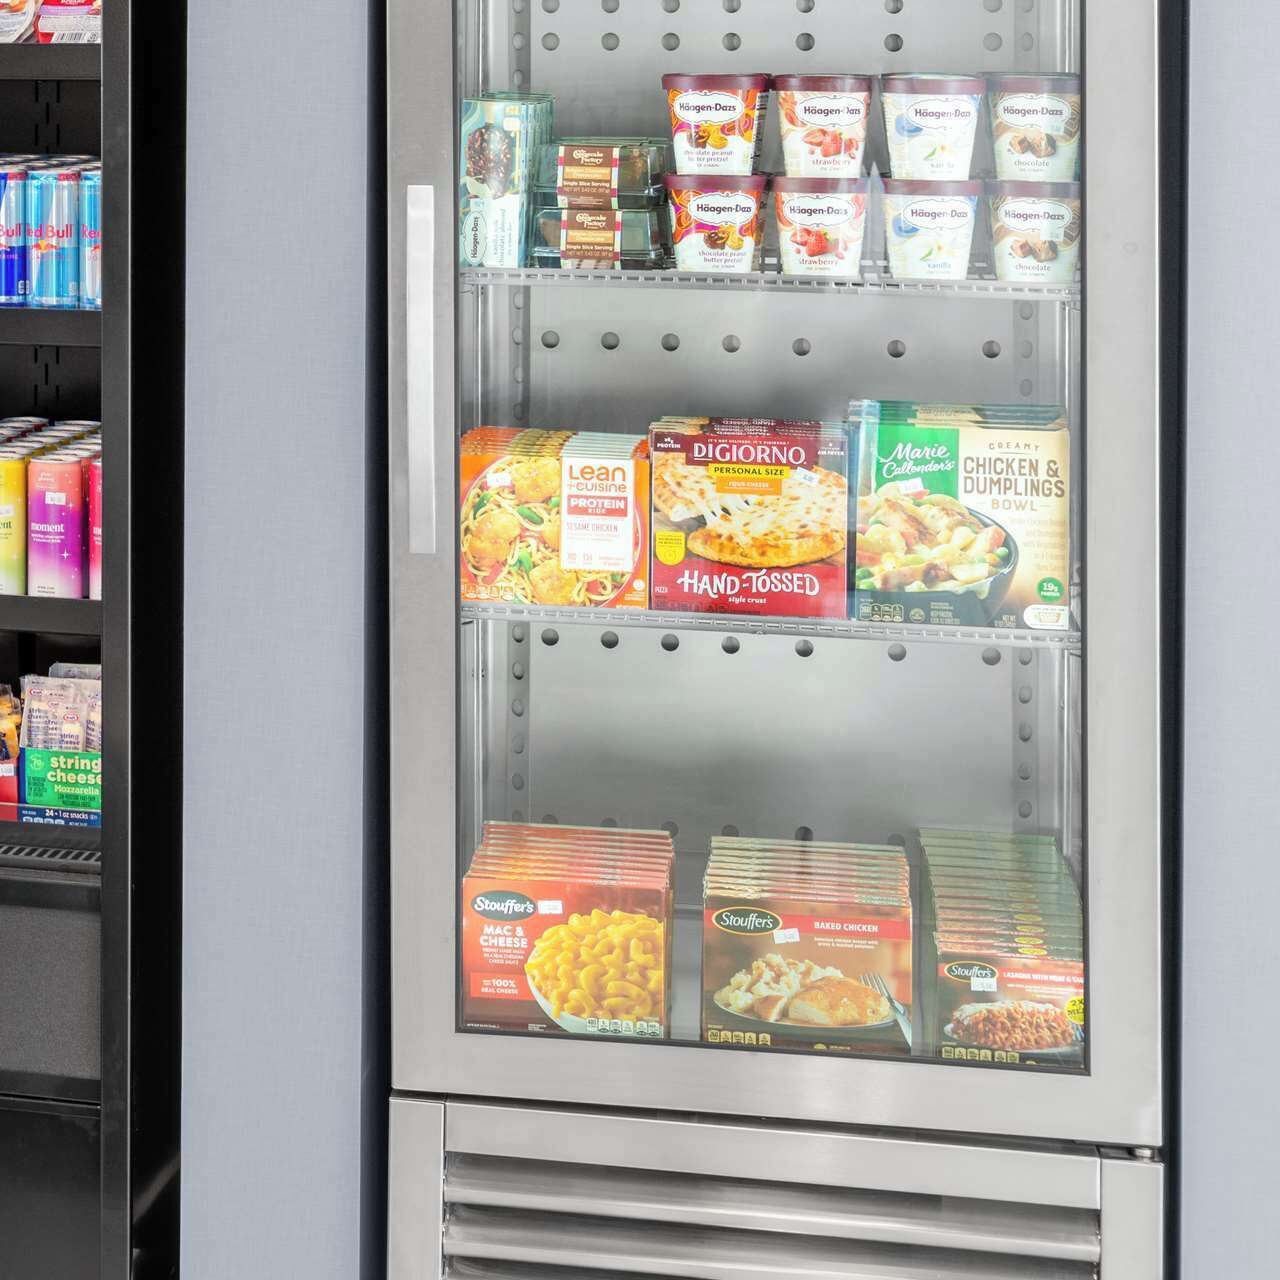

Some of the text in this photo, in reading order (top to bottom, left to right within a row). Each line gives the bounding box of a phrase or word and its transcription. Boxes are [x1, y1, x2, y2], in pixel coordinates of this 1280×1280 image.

[679, 102, 736, 114] Häagen-Dazs
[1003, 105, 1064, 116] Häagen-Dazs
[1014, 159, 1049, 167] chocolate
[696, 203, 752, 215] Häagen-Dazs
[1004, 209, 1065, 221] Häagen-Dazs
[46, 223, 72, 238] Bull
[1015, 263, 1051, 271] chocolate
[884, 442, 951, 462] Marie
[989, 441, 1040, 451] CREAMY
[694, 443, 806, 464] DIGIORNO
[569, 465, 626, 482] Lean
[714, 466, 785, 476] PERSONAL SIZE
[882, 460, 956, 479] Callender's
[963, 457, 1060, 479] CHICKEN &
[963, 476, 1065, 498] DUMPLINGS
[570, 498, 625, 509] PROTEIN
[991, 498, 1038, 512] BOWL
[31, 522, 65, 533] moment
[591, 523, 618, 533] CHICKEN
[677, 568, 820, 598] HAND-TOSSED
[728, 595, 746, 604] style
[50, 756, 101, 773] string
[47, 770, 101, 785] cheese
[54, 784, 100, 795] Mozzarella
[45, 809, 89, 820] 24 snacks
[474, 895, 534, 915] Stouffer's
[720, 910, 773, 931] Stouffer's
[483, 924, 524, 937] MAC &
[814, 921, 878, 933] BAKED CHICKEN
[479, 936, 528, 949] CHEESE
[950, 963, 992, 978] Stouffer's
[492, 978, 516, 988] 100%
